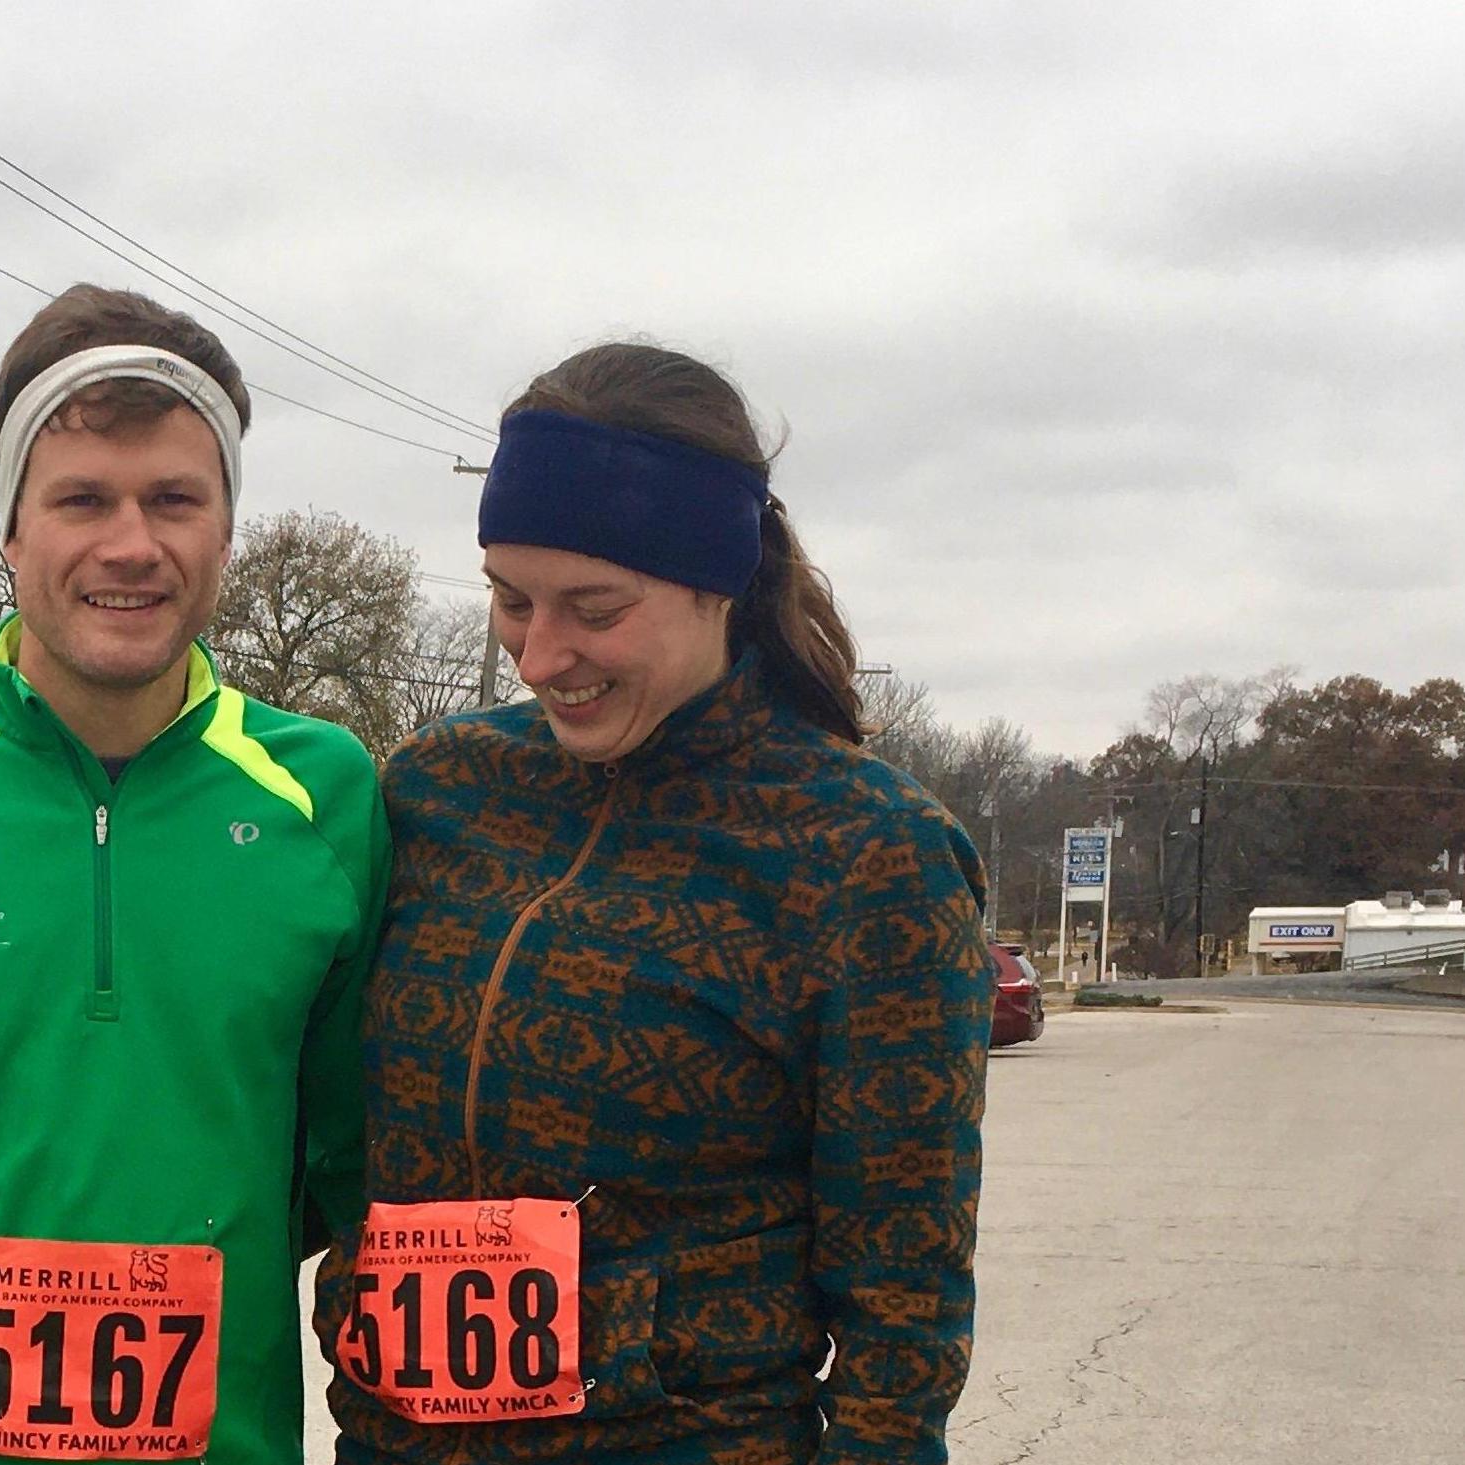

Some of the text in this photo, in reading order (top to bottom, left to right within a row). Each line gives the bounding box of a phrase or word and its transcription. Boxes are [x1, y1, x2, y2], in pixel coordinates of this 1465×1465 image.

[1271, 926, 1331, 936] EXIT ONLY
[364, 1229, 468, 1250] MERRILL
[398, 1255, 413, 1265] OF
[416, 1253, 467, 1265] AMERICA
[470, 1252, 531, 1264] COMPANY
[2, 1292, 37, 1303] BANK
[41, 1294, 56, 1304] OF
[60, 1294, 119, 1306] AMERICA
[123, 1297, 184, 1309] COMPANY
[346, 1268, 560, 1390] 5168
[421, 1396, 490, 1414] FAMILY
[498, 1393, 558, 1411] YMCA
[58, 1434, 132, 1452] FAMILY
[136, 1435, 188, 1452] YMCA
